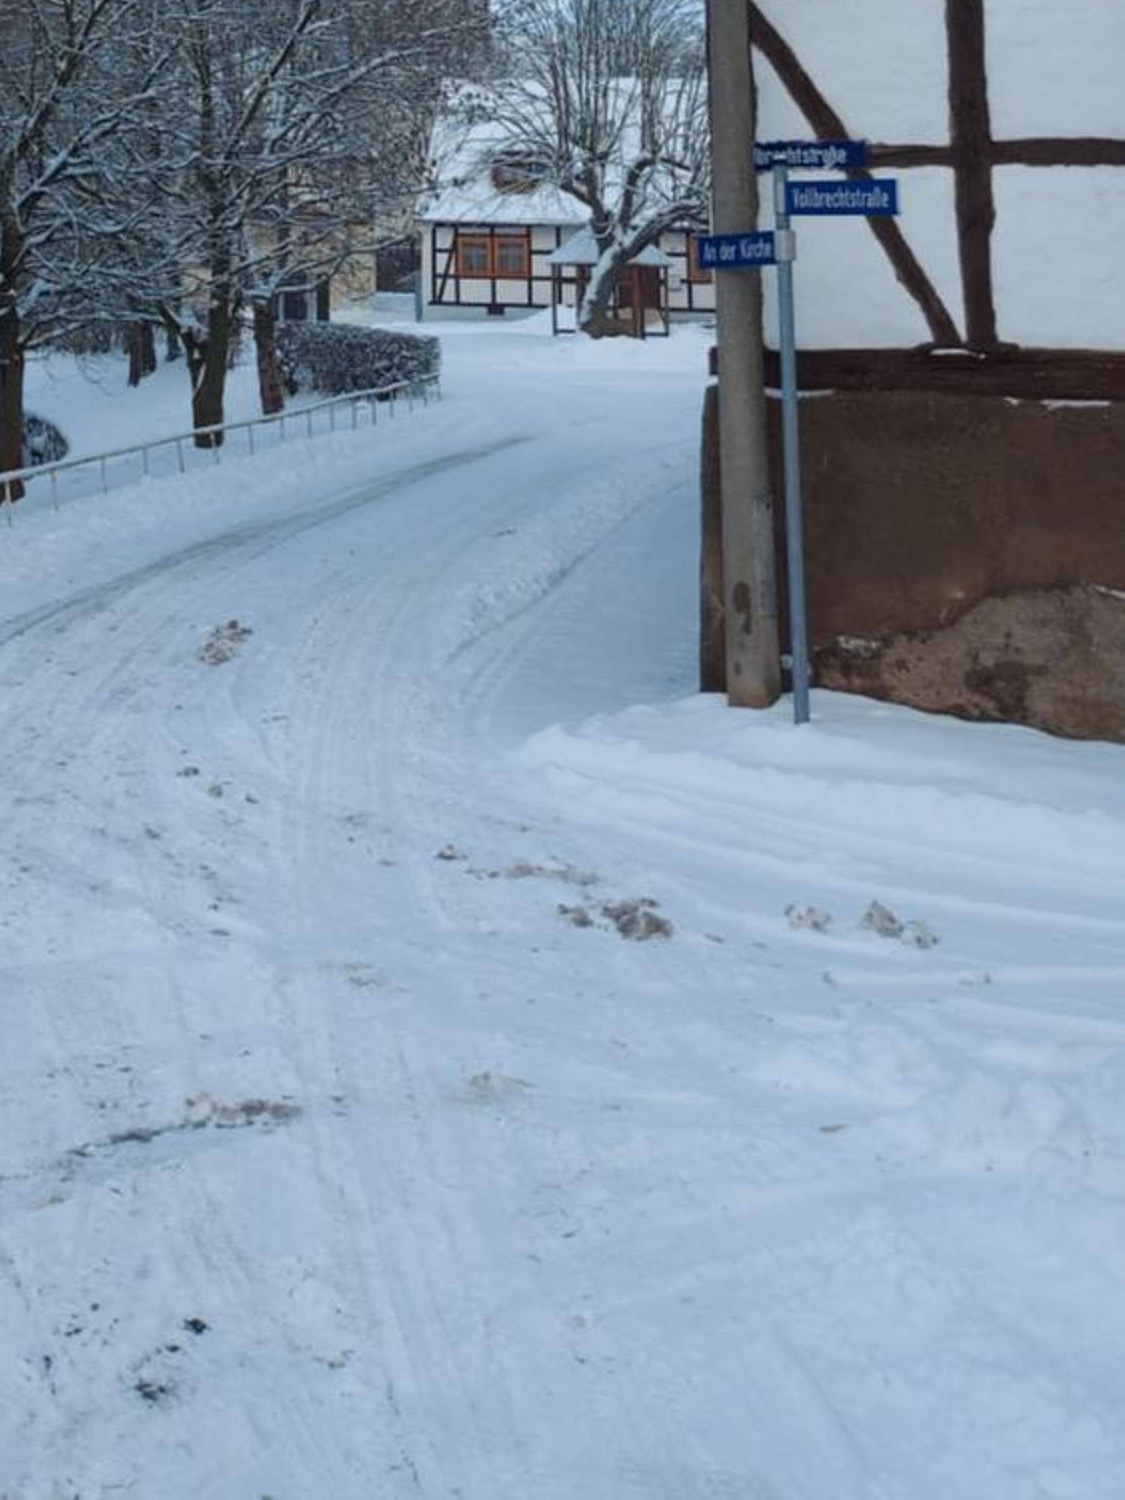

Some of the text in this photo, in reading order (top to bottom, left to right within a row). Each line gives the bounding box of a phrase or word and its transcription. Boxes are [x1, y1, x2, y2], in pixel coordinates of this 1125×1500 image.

[794, 186, 890, 209] Vollbrechtstraße
[703, 238, 772, 260] An der Kirche
